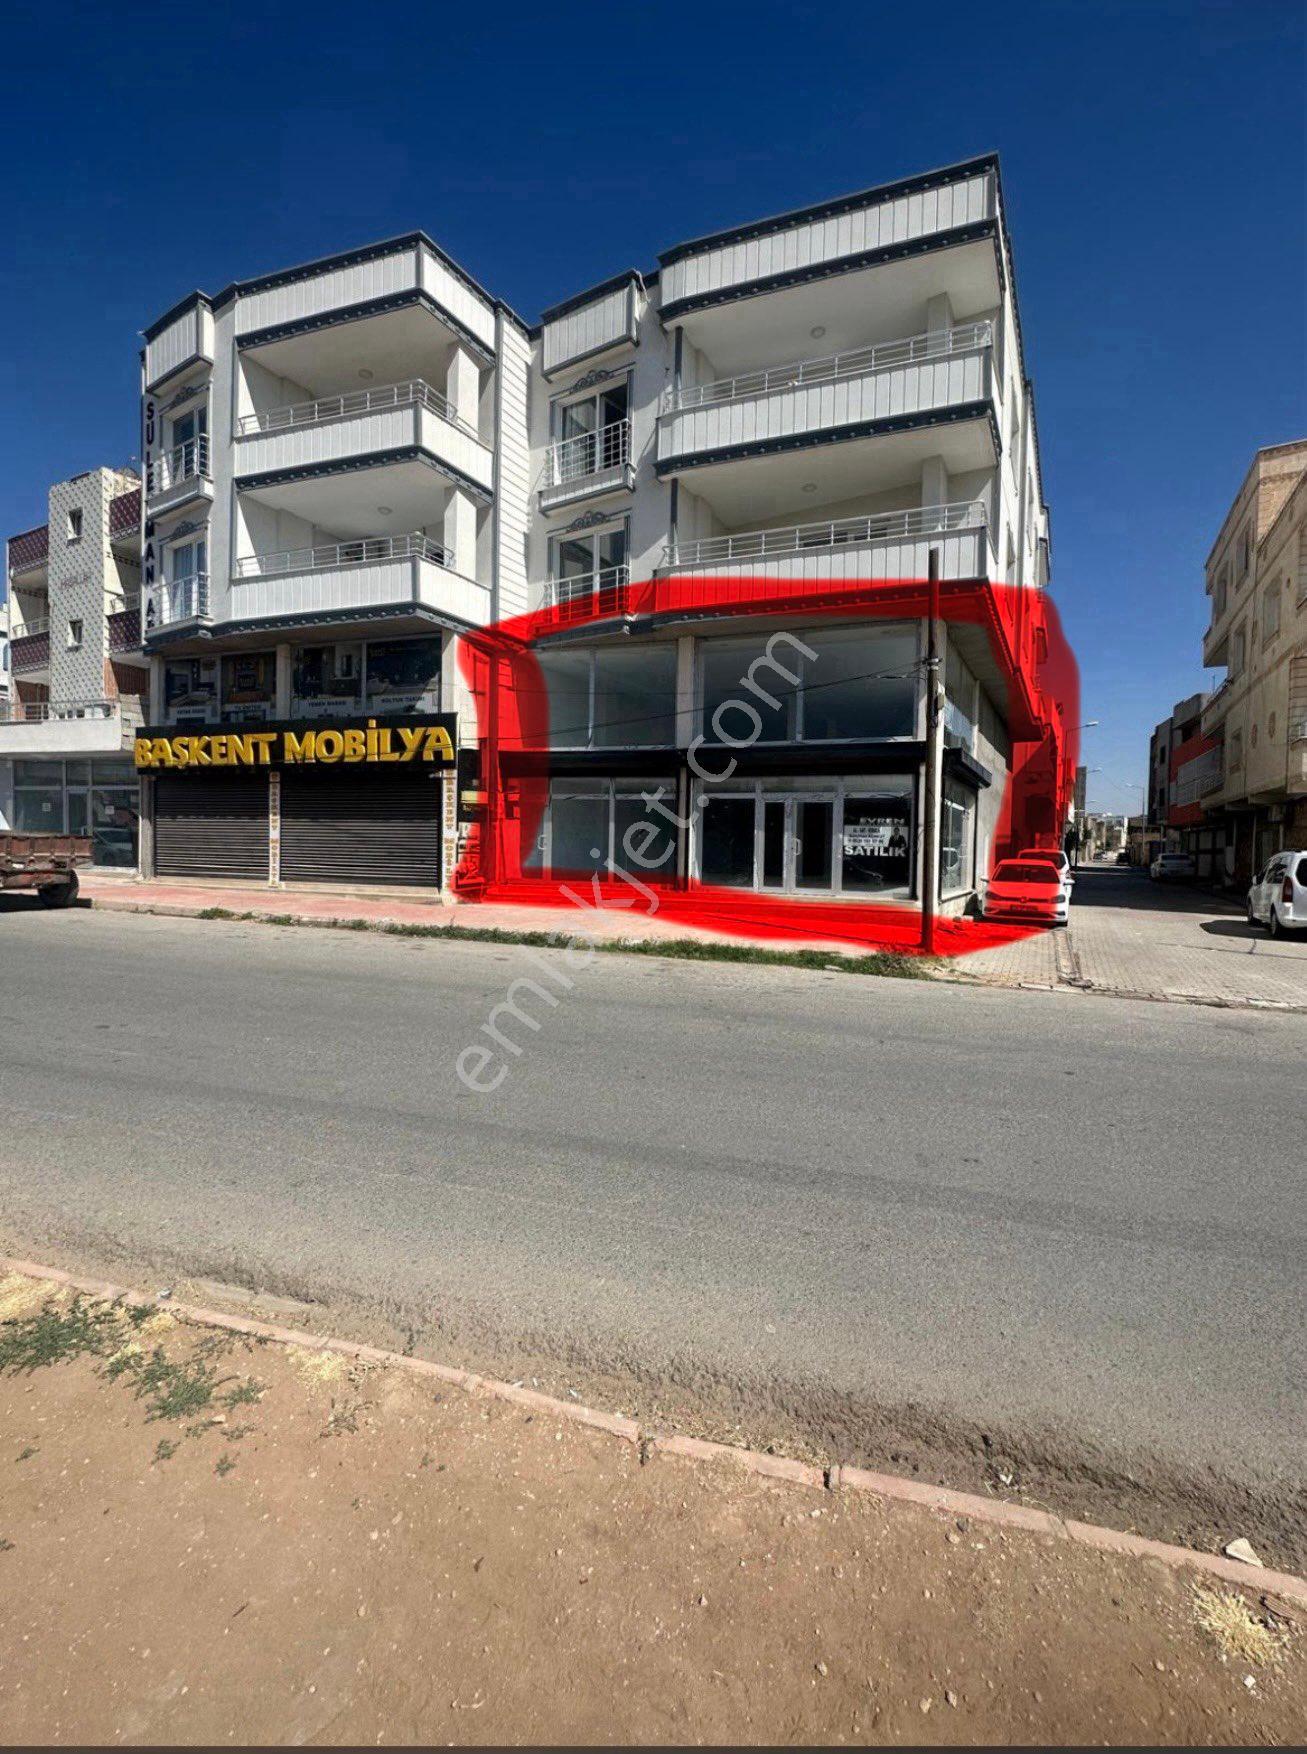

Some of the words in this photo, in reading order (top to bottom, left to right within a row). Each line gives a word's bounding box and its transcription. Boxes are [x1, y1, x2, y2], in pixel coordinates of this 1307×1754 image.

[136, 733, 278, 768] BAŞKENT
[284, 719, 456, 763] MOBİLYA
[845, 846, 906, 857] SATILIK
